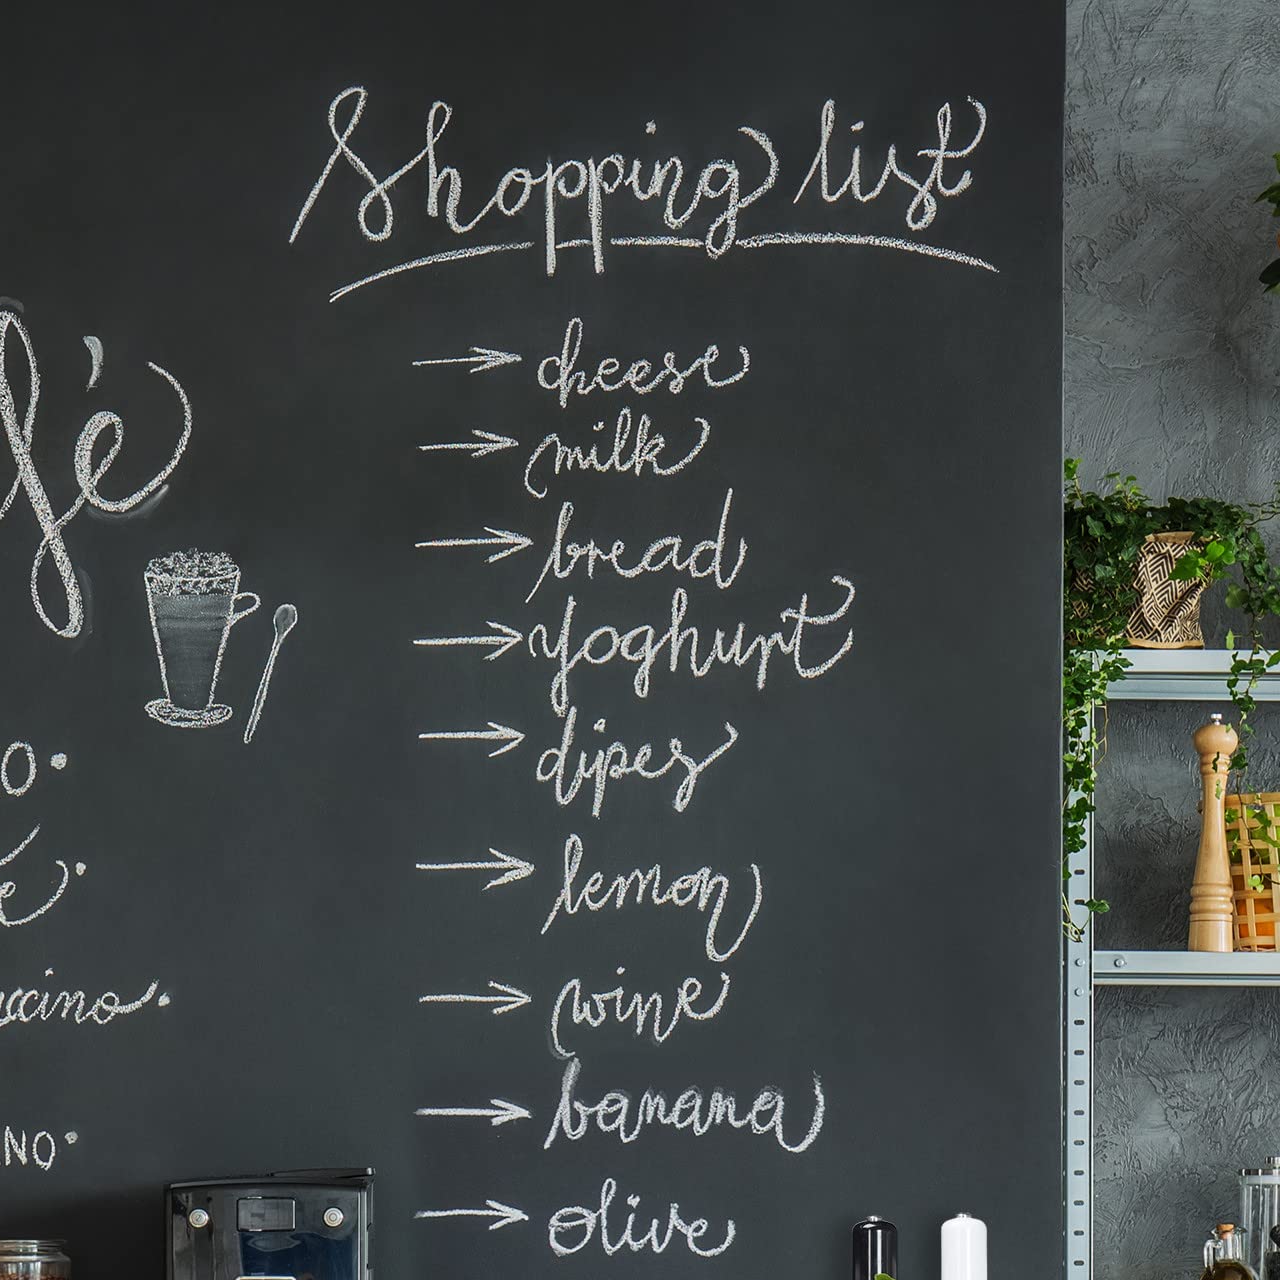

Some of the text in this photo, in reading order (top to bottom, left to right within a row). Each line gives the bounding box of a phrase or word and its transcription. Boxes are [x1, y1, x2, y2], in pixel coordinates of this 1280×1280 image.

[289, 87, 987, 277] Shopping list
[537, 317, 751, 409] cheese
[524, 406, 711, 498] milk
[525, 487, 748, 604] bread
[540, 832, 763, 963] lemon
[548, 966, 731, 1059] wine
[543, 1056, 826, 1154] banana
[547, 1177, 737, 1258] olive
